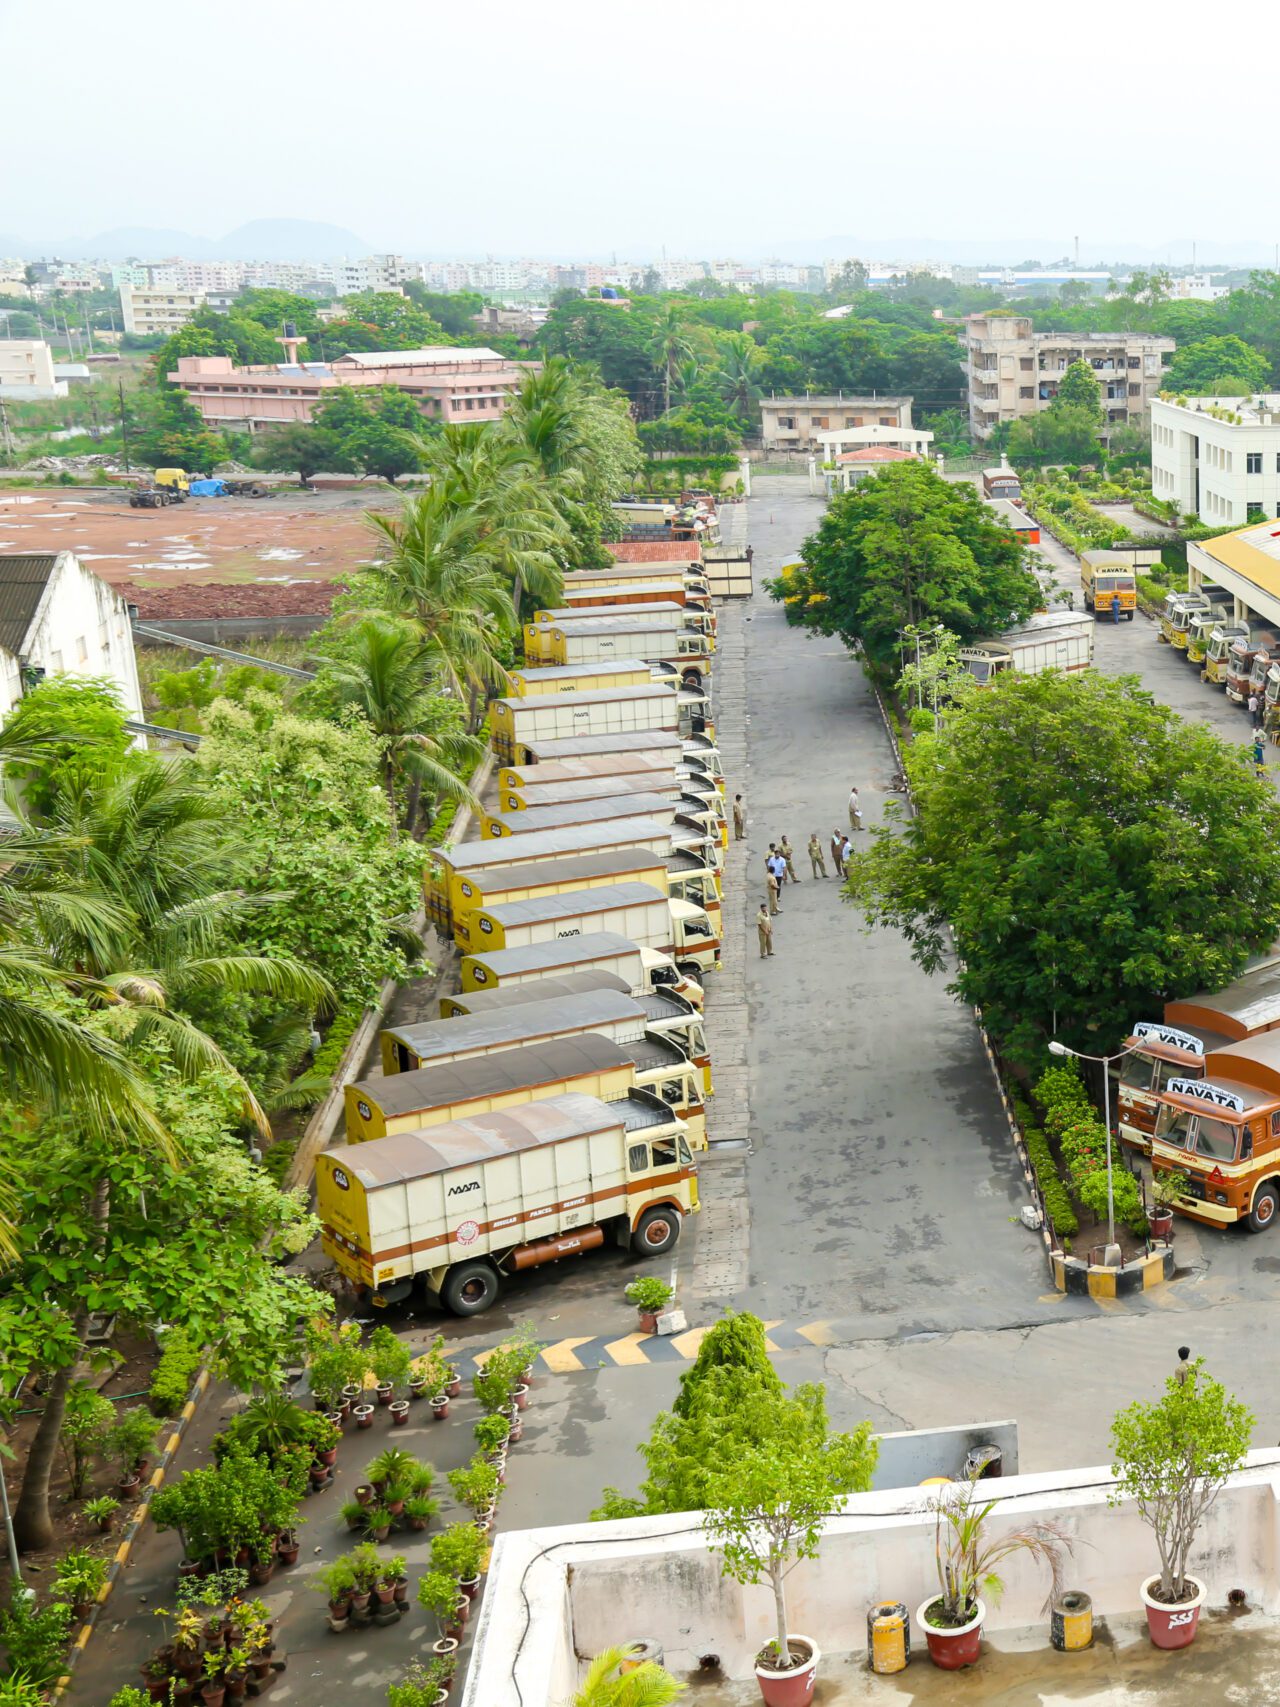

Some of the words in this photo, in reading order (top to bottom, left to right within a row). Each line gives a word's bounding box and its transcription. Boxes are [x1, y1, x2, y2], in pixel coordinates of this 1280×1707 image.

[961, 648, 986, 657] NAVATA
[1138, 1029, 1197, 1054] NVATA
[1172, 1083, 1237, 1111] NAVATA
